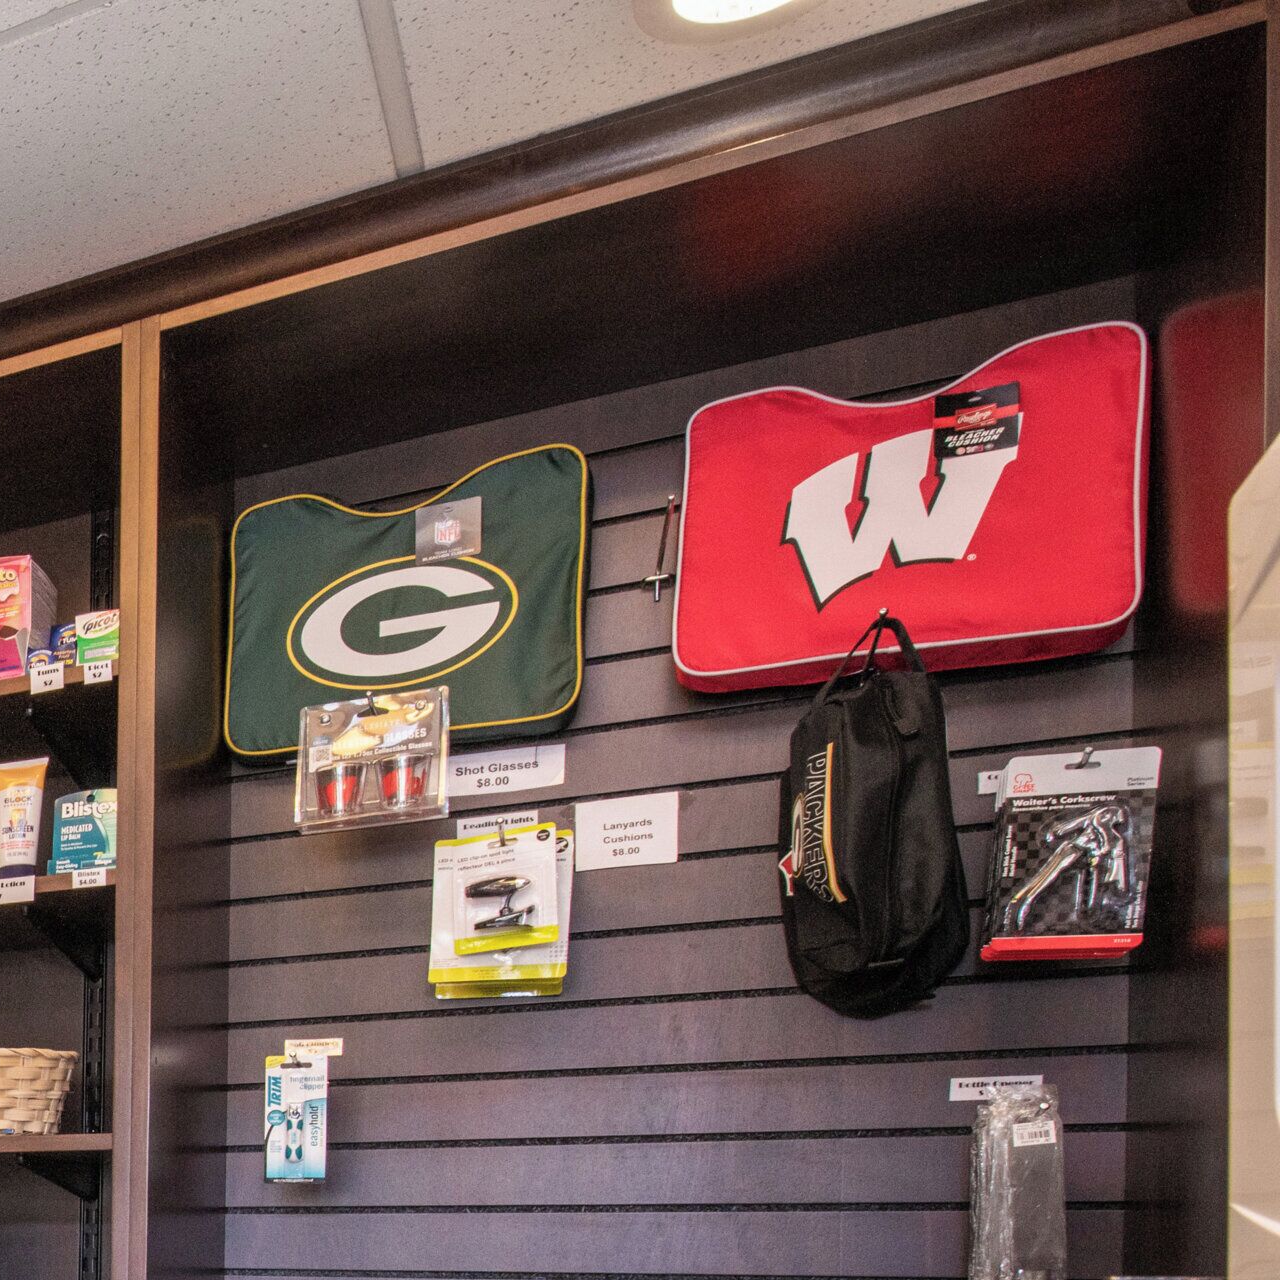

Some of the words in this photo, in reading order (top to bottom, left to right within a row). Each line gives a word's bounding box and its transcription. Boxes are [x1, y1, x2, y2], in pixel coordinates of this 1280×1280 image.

[944, 427, 1006, 443] BLEACHER
[947, 433, 1001, 448] CUSHION
[782, 412, 1024, 612] W
[83, 613, 118, 635] picot
[300, 565, 501, 677] G
[37, 668, 60, 676] Tums
[455, 762, 485, 777] Shot
[488, 759, 539, 774] Glasses
[476, 775, 510, 789] $8.00
[1126, 775, 1155, 783] Platinum
[4, 796, 32, 804] BLOCK
[1012, 796, 1057, 807] Waiter's
[1059, 794, 1117, 804] Corkscrew
[61, 801, 117, 820] Blistex
[1, 826, 35, 834] SUNSCREEN
[60, 824, 93, 835] MEDICATED
[463, 819, 498, 831] Readin
[603, 816, 653, 832] Lanyards
[804, 751, 833, 903] PACKERS
[8, 832, 27, 840] LOTION
[603, 831, 654, 845] Cushions
[612, 846, 641, 858] $8.00
[1, 880, 26, 889] Lotion
[289, 1074, 325, 1084] fingernail
[958, 1080, 991, 1089] Bottle
[992, 1079, 1035, 1088] Opener
[267, 1075, 283, 1107] TRIM
[299, 1082, 325, 1091] clipper
[309, 1104, 321, 1147] easyhold
